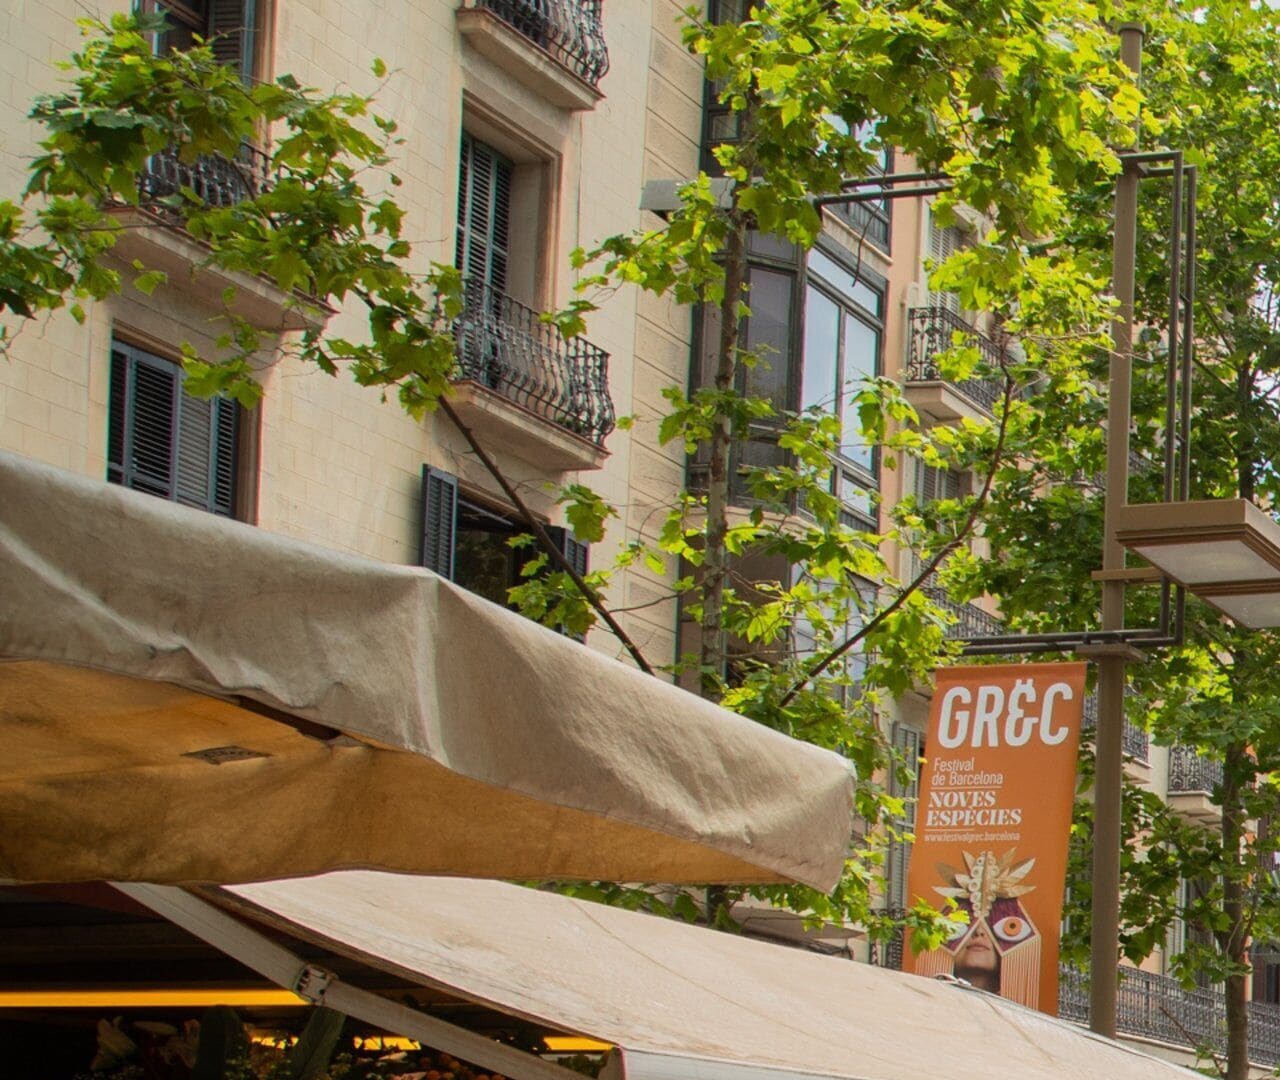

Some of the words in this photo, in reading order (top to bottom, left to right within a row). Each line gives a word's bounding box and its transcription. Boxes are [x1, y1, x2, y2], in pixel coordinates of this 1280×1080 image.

[933, 757, 975, 772] Festival
[931, 774, 946, 786] de
[949, 771, 1004, 786] Barcelona
[928, 791, 996, 808] NOVES
[926, 807, 1022, 826] ESPÈCIES
